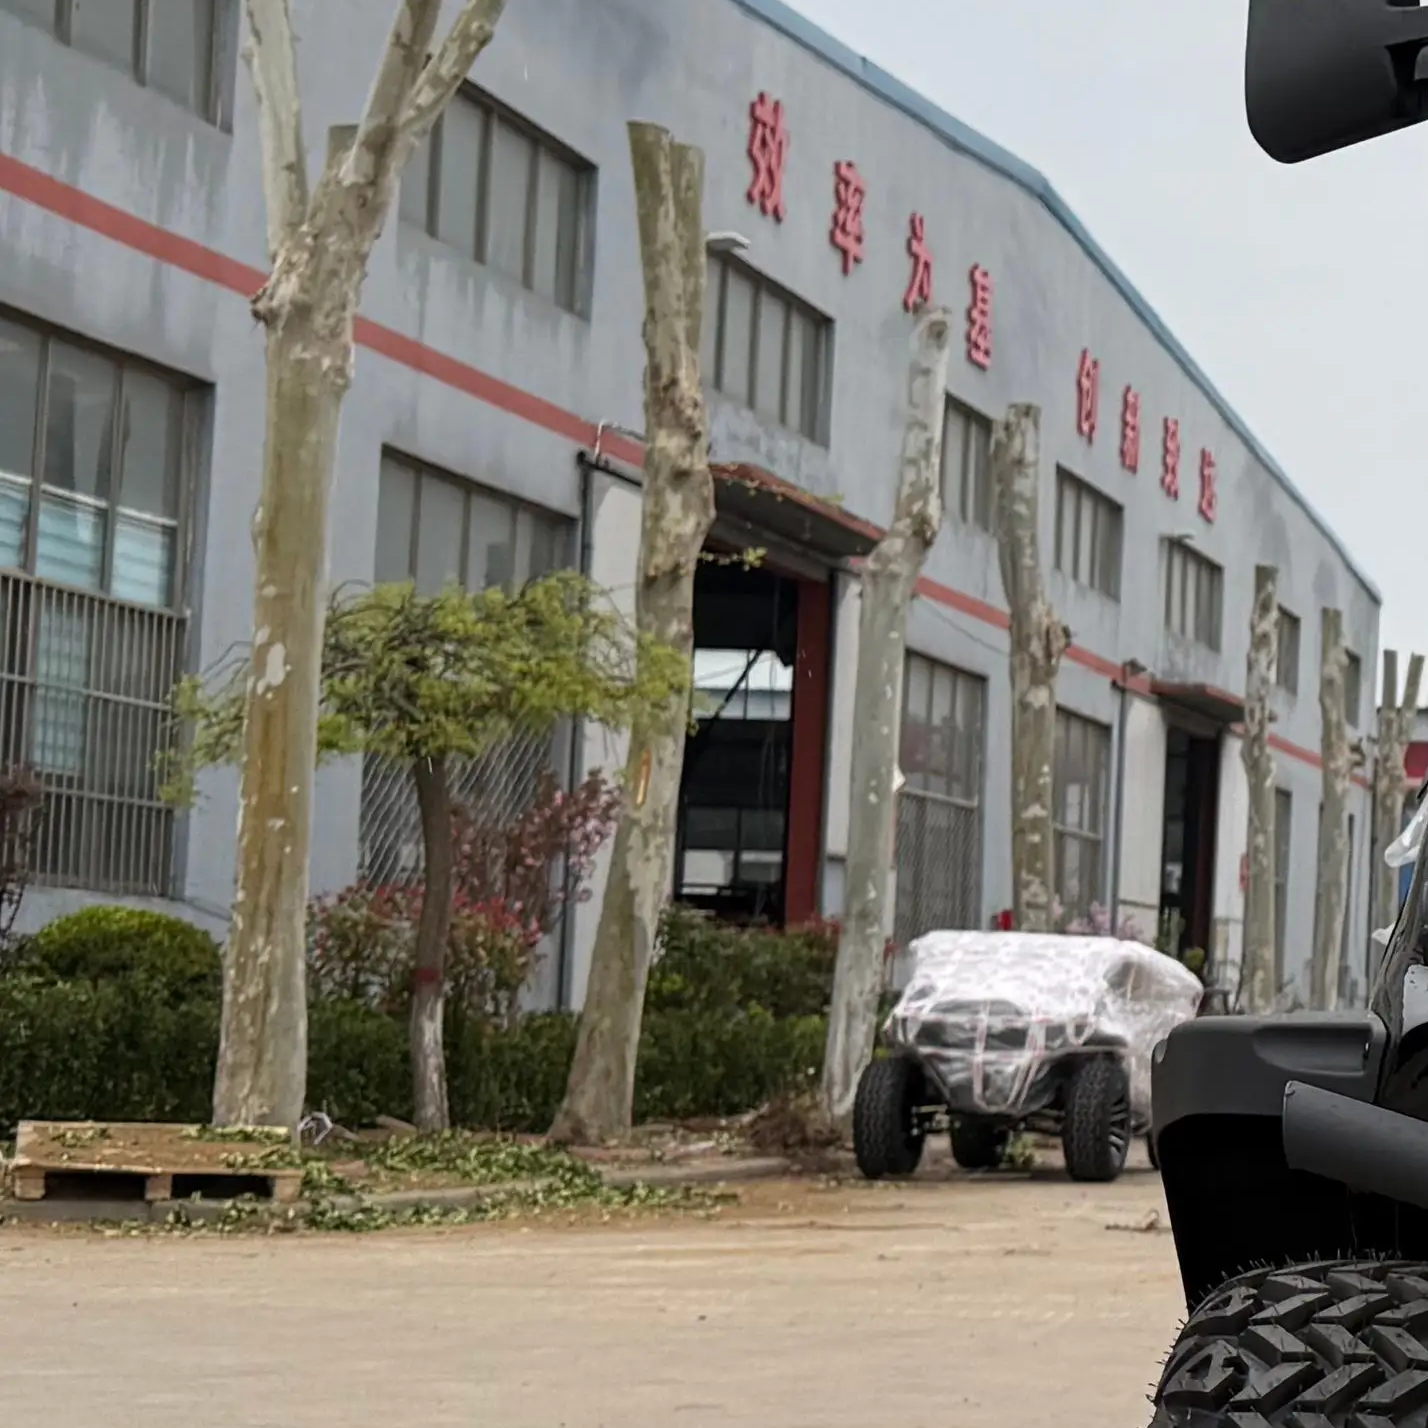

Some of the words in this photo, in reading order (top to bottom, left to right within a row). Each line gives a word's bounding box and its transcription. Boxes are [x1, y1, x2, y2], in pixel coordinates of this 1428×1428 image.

[747, 91, 990, 372] 效率为基
[1077, 348, 1217, 525] 创新致远
